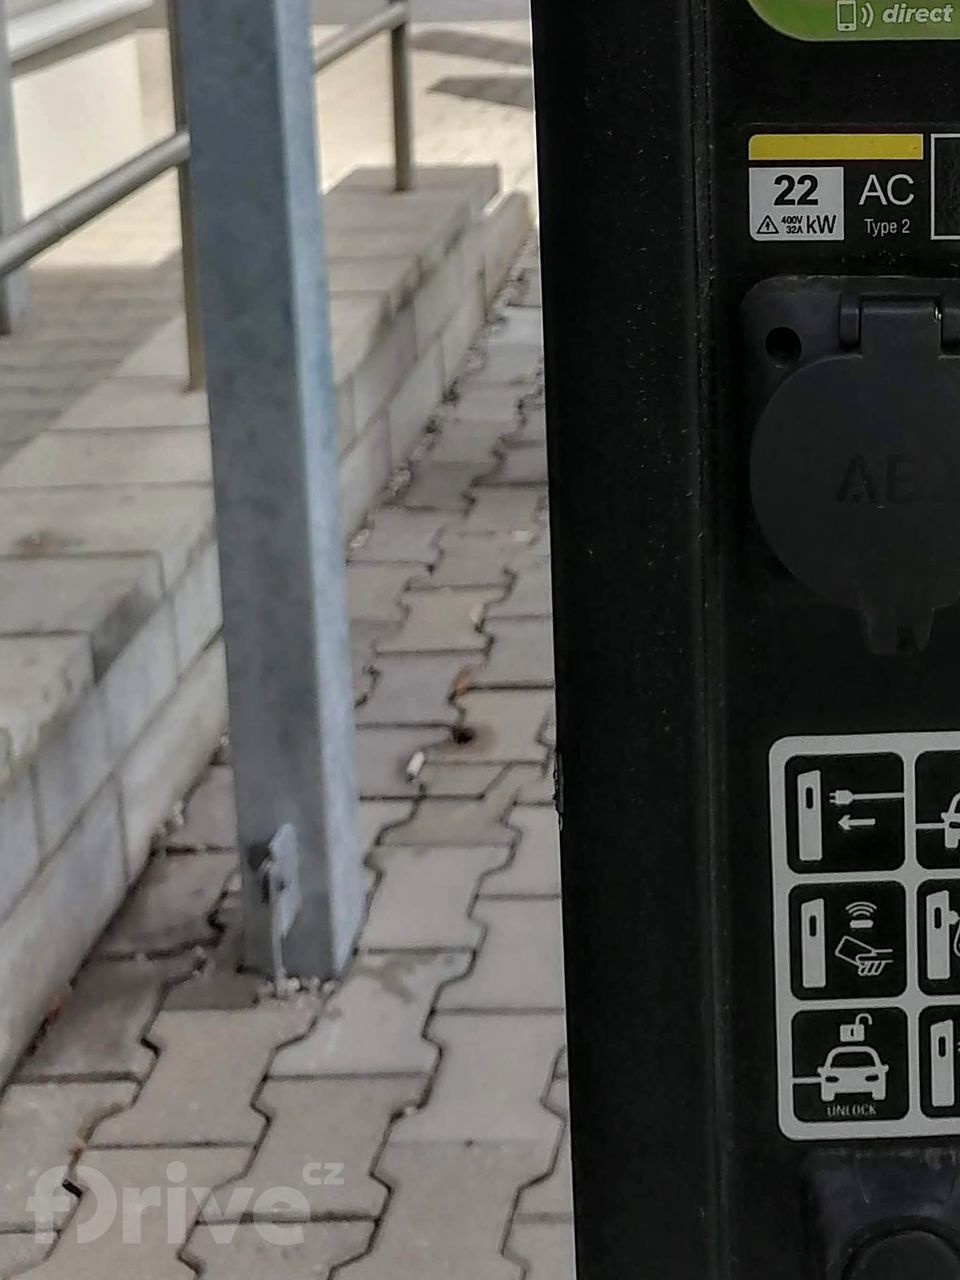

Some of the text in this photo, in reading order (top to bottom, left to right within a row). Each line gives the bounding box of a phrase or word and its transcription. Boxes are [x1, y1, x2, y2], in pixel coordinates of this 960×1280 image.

[882, 3, 954, 24] direct
[773, 174, 819, 206] 22
[858, 173, 915, 206] AC
[806, 214, 837, 234] kW
[864, 218, 910, 237] Type 2
[826, 1103, 878, 1119] UNLOCK
